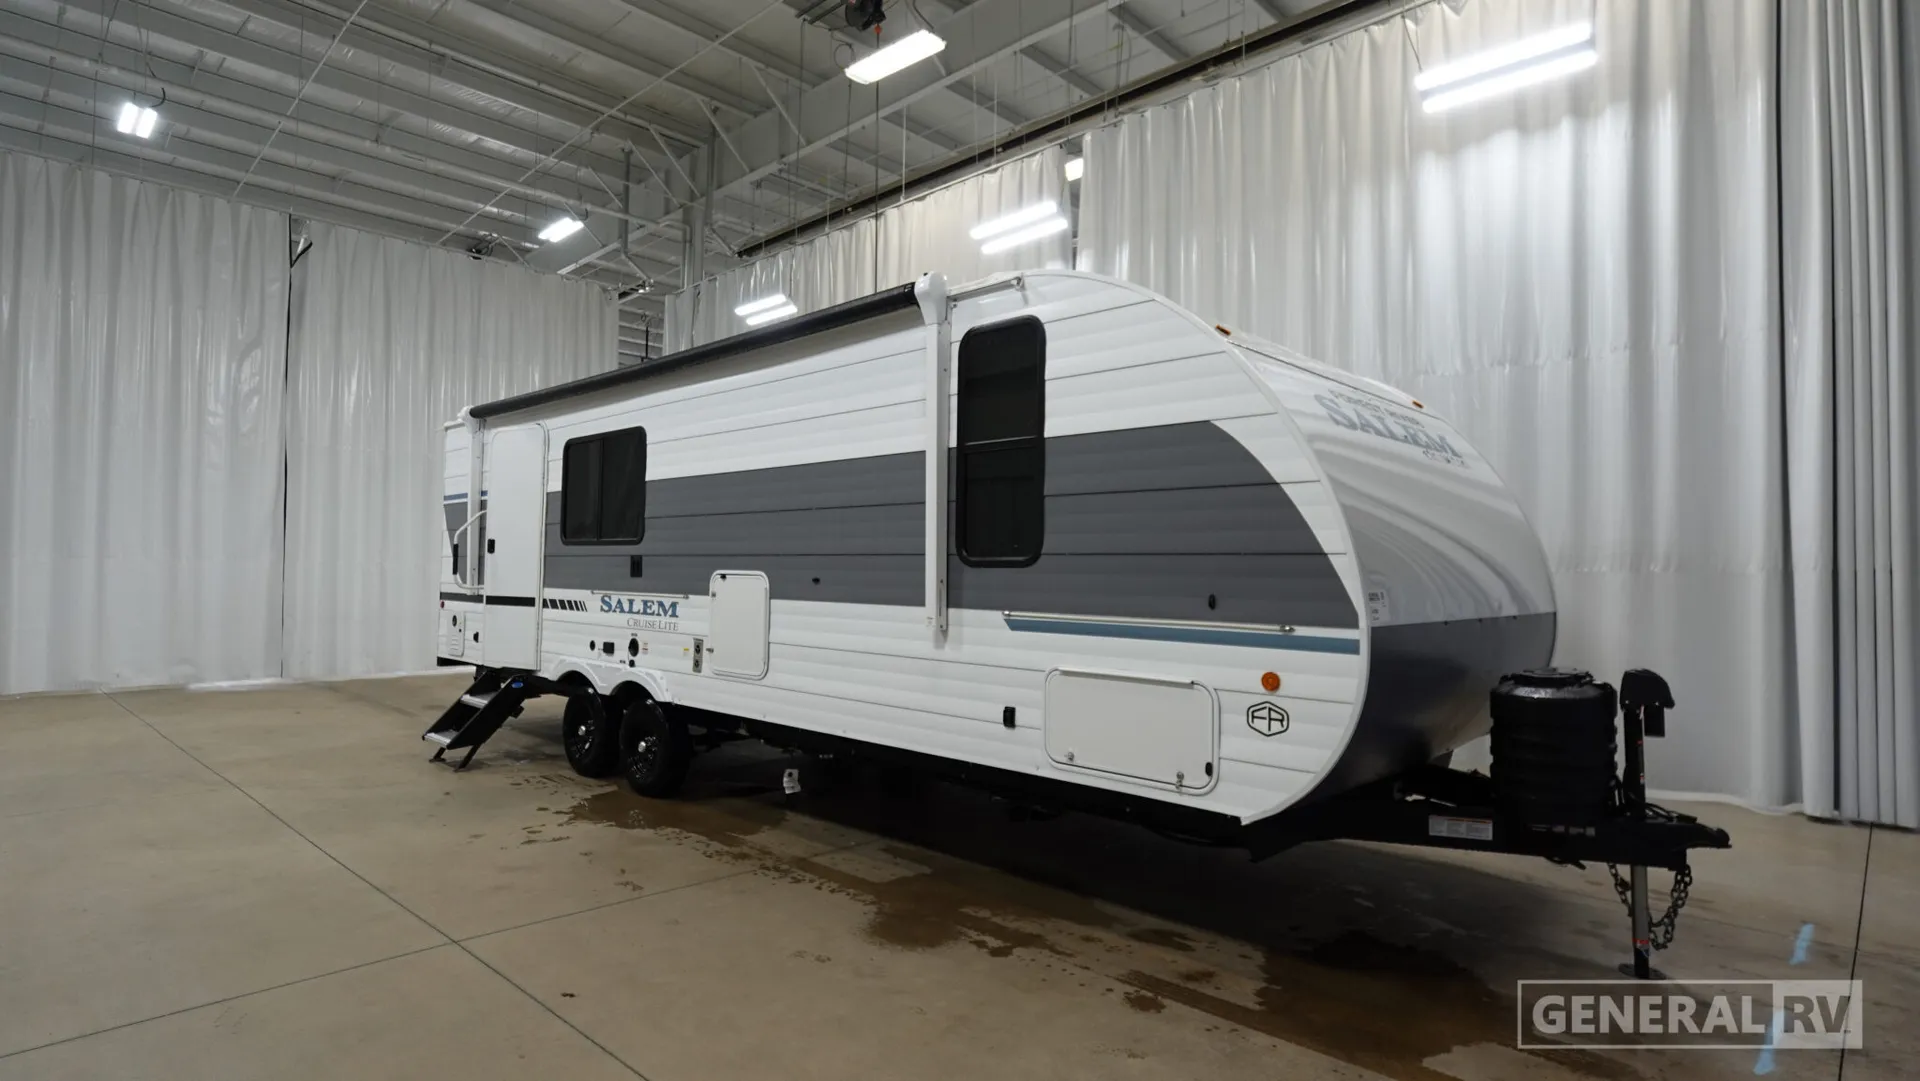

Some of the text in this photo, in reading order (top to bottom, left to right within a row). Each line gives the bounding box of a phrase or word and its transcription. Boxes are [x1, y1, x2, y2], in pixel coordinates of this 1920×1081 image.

[1314, 394, 1462, 459] SALEM
[600, 595, 679, 618] SALEM
[1251, 706, 1285, 732] FR
